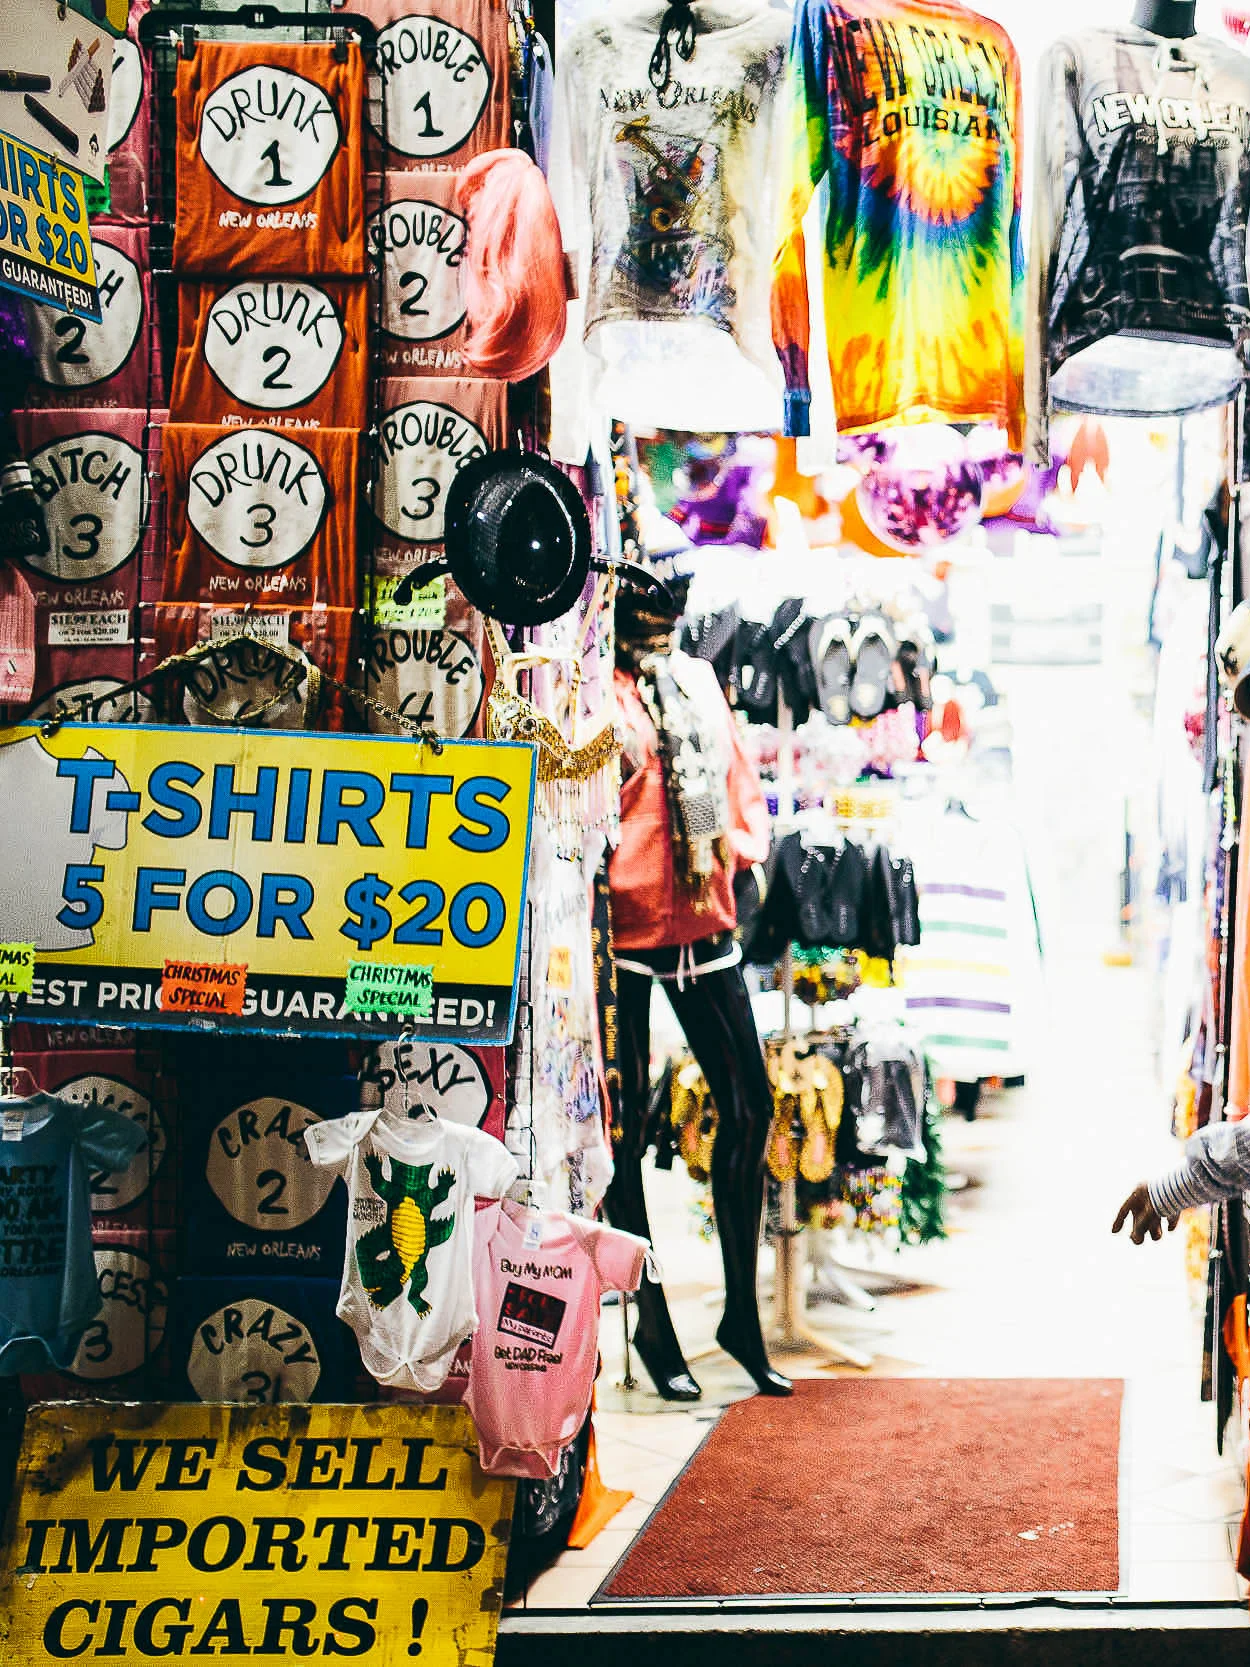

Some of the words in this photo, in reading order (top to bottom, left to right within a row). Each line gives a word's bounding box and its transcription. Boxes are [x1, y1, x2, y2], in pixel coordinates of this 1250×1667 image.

[206, 79, 332, 143] DRUNK
[413, 91, 444, 137] 1
[863, 106, 1000, 147] LOUISIAN
[1093, 91, 1156, 137] NEW
[261, 140, 292, 186] 1
[219, 211, 250, 228] NEW
[256, 211, 318, 229] ORLEANS
[369, 211, 465, 267] ROUBLE
[36, 213, 88, 275] $20
[2, 258, 94, 310] GUARANTEED!
[400, 272, 429, 315] 2
[213, 284, 335, 348] DRUNK
[55, 316, 88, 364] 2
[262, 345, 293, 389] 2
[31, 447, 131, 502] BITCH
[192, 443, 317, 508] DRUNK
[400, 477, 440, 520] 3
[62, 513, 103, 560] 3
[240, 504, 276, 547] 3
[64, 587, 125, 606] ORLEANS
[209, 575, 239, 591] NEW
[245, 574, 307, 592] ORLEANS
[56, 757, 512, 853] T-SHIRTS
[56, 863, 105, 931] 5
[132, 866, 315, 941] FOR
[340, 872, 507, 951] $20
[163, 964, 241, 986] CHRISTMAS
[169, 987, 227, 1009] SPECIAL
[350, 964, 433, 987] CHRISTMAS
[97, 981, 168, 1011] PRI
[241, 988, 496, 1028] GUARED!
[357, 989, 421, 1008] SPECIAL
[217, 1106, 315, 1159] CRAZ
[256, 1170, 289, 1215] 2
[227, 1243, 257, 1258] NEW
[262, 1243, 321, 1261] ORLEANS
[500, 1258, 522, 1277] Buy
[524, 1262, 541, 1280] My
[85, 1320, 114, 1362] 3
[201, 1308, 317, 1366] CRAZY
[513, 1346, 537, 1362] DAD
[88, 1434, 217, 1492] WE
[236, 1436, 448, 1493] SELL
[17, 1516, 486, 1575] IMPORTED
[43, 1597, 380, 1658] CIGARS
